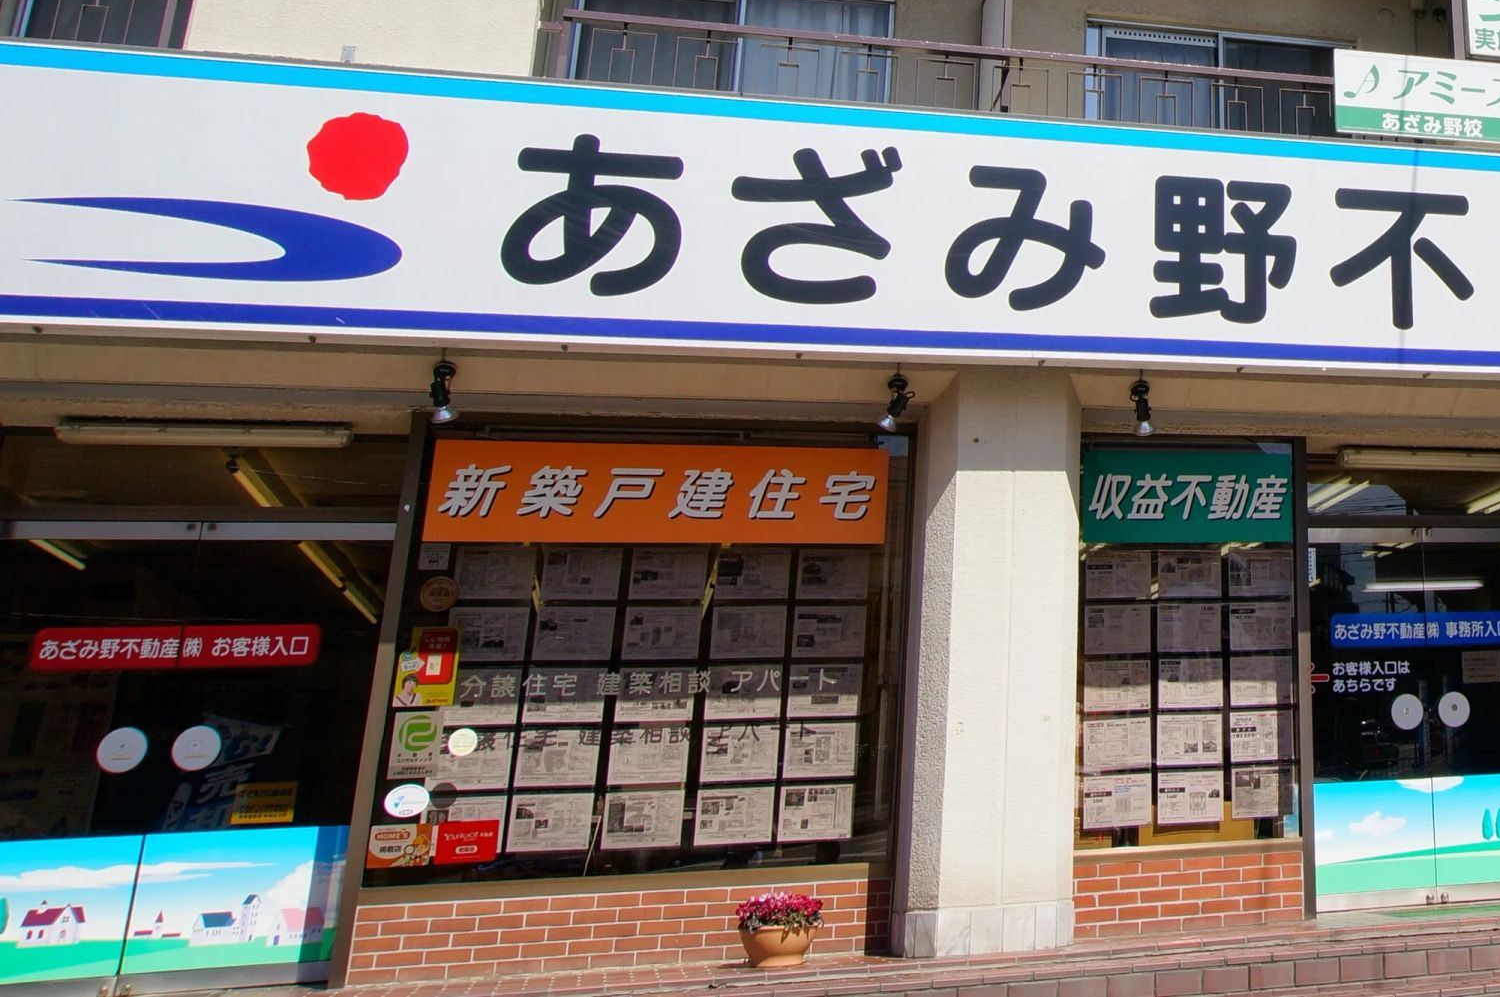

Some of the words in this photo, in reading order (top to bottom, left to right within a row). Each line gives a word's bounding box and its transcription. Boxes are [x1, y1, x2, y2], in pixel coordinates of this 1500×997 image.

[1382, 111, 1483, 138] あざみ野校
[438, 464, 876, 521] 新築戸建住宅
[1088, 472, 1289, 521] 収益不動産
[211, 636, 310, 658] お客様入口
[1332, 660, 1410, 676] お客様入口は
[459, 673, 578, 699] 分譲住宅
[596, 670, 712, 696] 建築相談
[731, 667, 838, 693] アパート
[1332, 677, 1397, 693] あちらです
